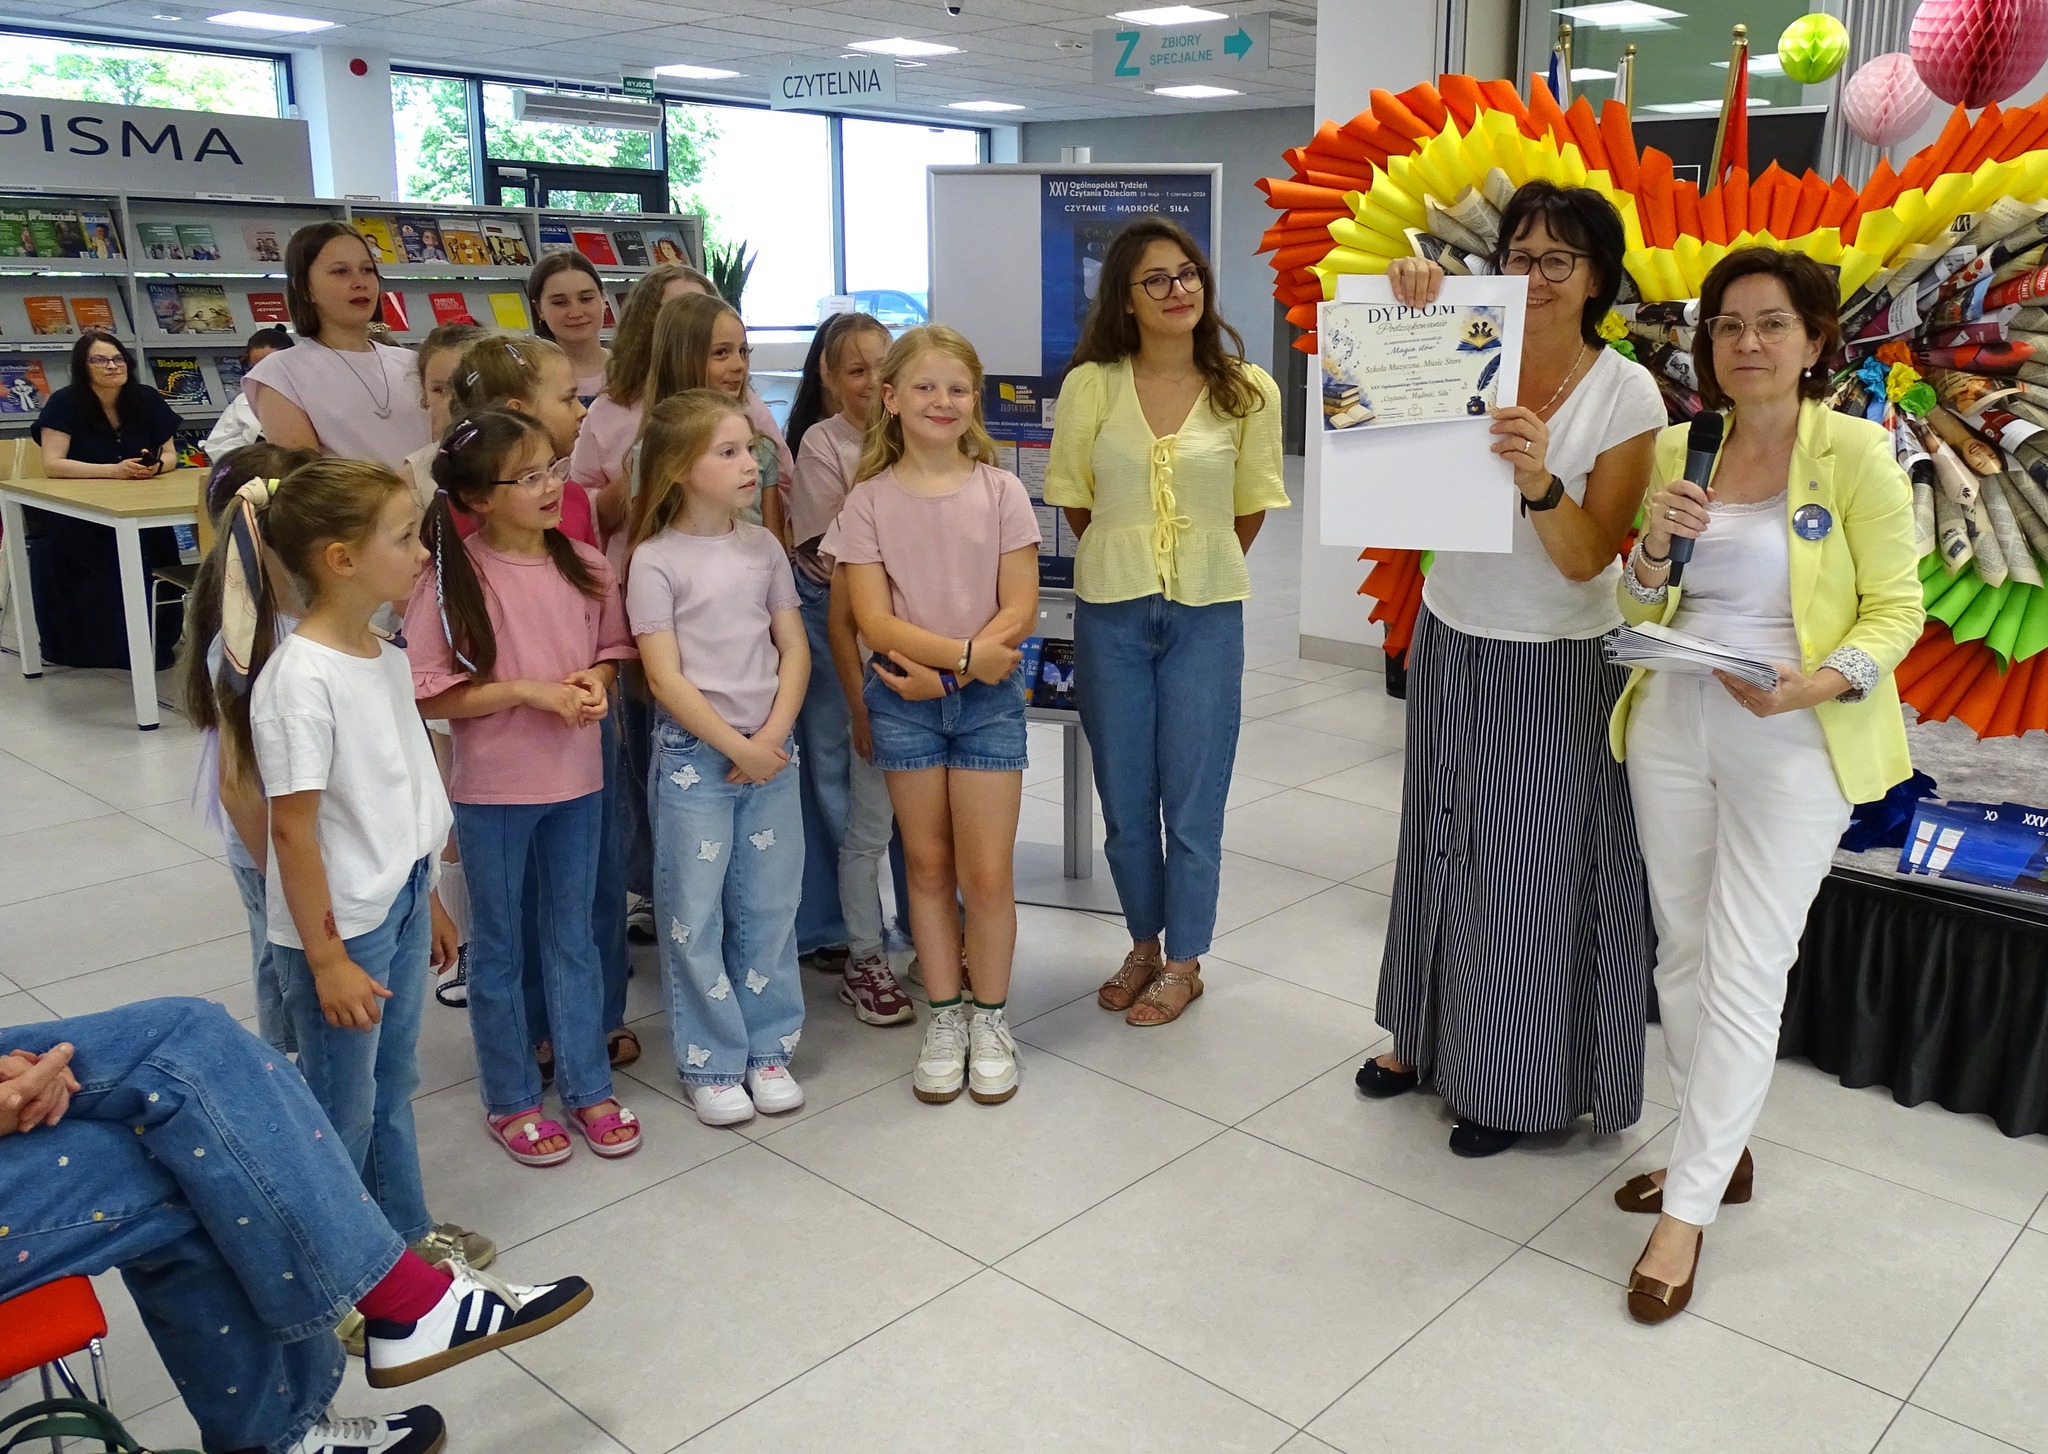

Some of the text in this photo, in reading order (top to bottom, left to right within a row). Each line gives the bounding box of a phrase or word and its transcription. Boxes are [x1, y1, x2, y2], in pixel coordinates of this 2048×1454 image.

[1161, 33, 1203, 49] ZBIORY
[1115, 31, 1140, 77] Z
[1149, 49, 1213, 66] SPECJALNE
[782, 68, 881, 99] CZYTELNIA
[1049, 181, 1148, 197] XXV Ogólnopolski Tydzień
[1069, 189, 1102, 198] Czytania
[1103, 189, 1137, 197] Dzieciom
[1064, 203, 1190, 213] CZYTANIE MĄDROŚĆ SIŁA
[1368, 304, 1456, 324] DYPLOM
[1376, 319, 1448, 335] Podziękowanie
[157, 359, 194, 369] Biologia
[1365, 365, 1387, 374] Szkoła
[1423, 359, 1443, 368] Music
[1445, 357, 1463, 365] Store
